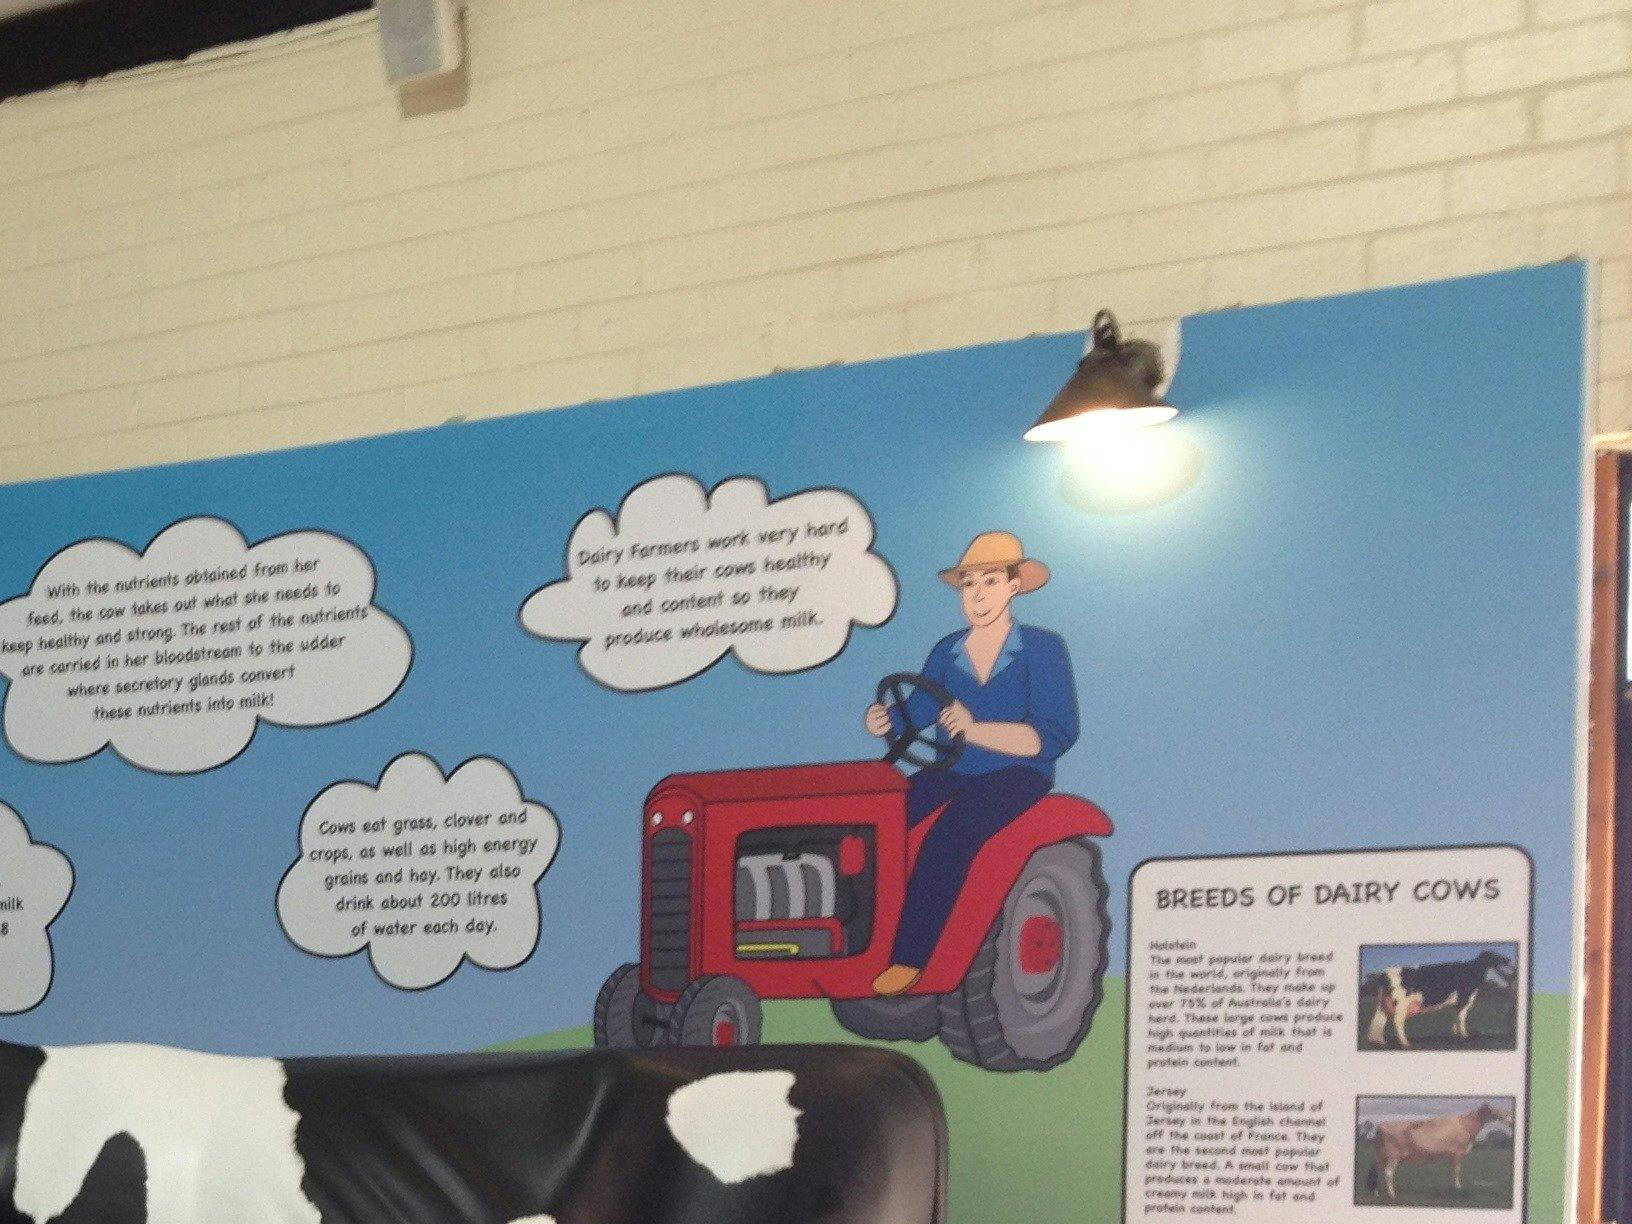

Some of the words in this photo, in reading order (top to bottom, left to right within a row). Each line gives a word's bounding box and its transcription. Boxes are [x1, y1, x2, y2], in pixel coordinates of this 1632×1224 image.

[577, 546, 623, 567] Dairy
[707, 529, 748, 549] work
[758, 527, 798, 544] very
[806, 517, 847, 537] hard
[47, 582, 79, 599] With
[85, 580, 109, 594] the
[114, 572, 179, 592] nutrients
[184, 563, 246, 586] obtained
[254, 561, 287, 576] from
[294, 558, 318, 572] her
[593, 575, 610, 592] to
[616, 573, 656, 591] keep
[664, 564, 706, 583] their
[714, 561, 755, 578] cows
[763, 551, 830, 571] healthy
[27, 609, 63, 627] feed,
[69, 607, 92, 621] the
[98, 606, 125, 620] cow
[131, 599, 168, 616] takes
[173, 595, 197, 612] out
[203, 591, 237, 608] what
[244, 589, 268, 605] she
[275, 582, 318, 601] needs
[326, 581, 340, 596] to
[621, 598, 652, 617] and
[660, 590, 724, 613] content
[731, 591, 750, 605] so
[758, 585, 798, 603] they
[0, 638, 33, 655] keep
[38, 632, 90, 650] healthy
[95, 628, 121, 646] and
[181, 621, 206, 635] The
[213, 616, 241, 633] rest
[247, 613, 262, 631] of
[269, 612, 294, 626] the
[300, 603, 368, 624] nutrients
[604, 627, 672, 651] produce
[680, 618, 773, 638] wholesome
[318, 820, 355, 835] Cows
[362, 816, 386, 833] eat
[393, 817, 436, 836] grass,
[443, 812, 491, 828] clover
[498, 807, 527, 825] and
[309, 847, 352, 864] crops,
[359, 846, 375, 859] as
[382, 841, 412, 857] well
[419, 843, 436, 856] as
[443, 838, 476, 859] high
[483, 838, 537, 855] energy
[324, 869, 368, 890] grains
[375, 867, 402, 884] and
[446, 865, 482, 883] They
[489, 863, 520, 879] also
[335, 895, 373, 911] drink
[380, 893, 422, 910] about
[430, 892, 460, 908] 200
[467, 890, 507, 906] litres
[1156, 886, 1254, 909] BREEDS
[1267, 884, 1301, 906] OF
[1314, 880, 1399, 905] DAIRY
[1413, 878, 1499, 901] COWS
[351, 920, 366, 937] of
[373, 920, 416, 935] water
[423, 918, 458, 934] each
